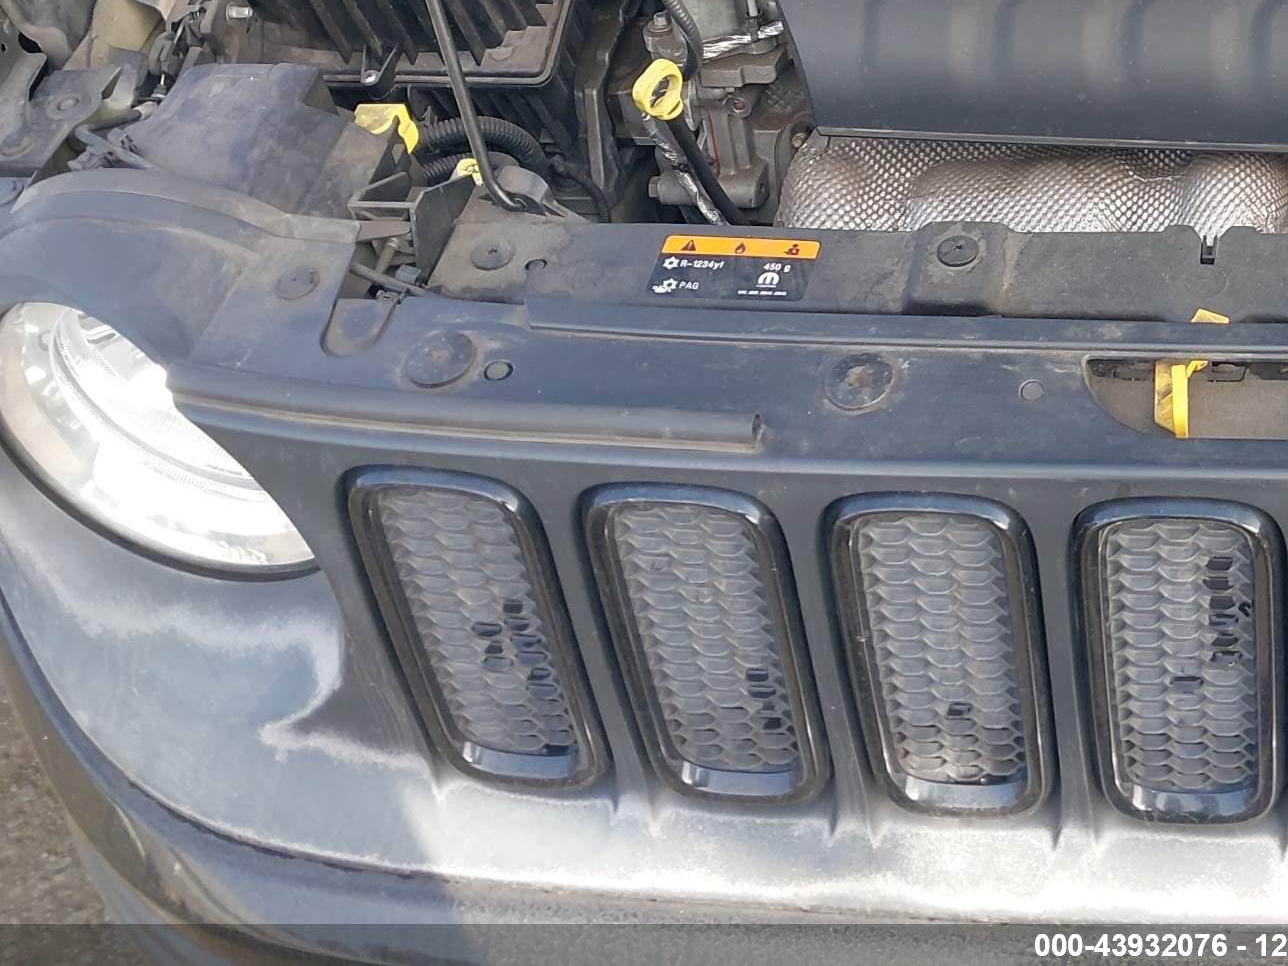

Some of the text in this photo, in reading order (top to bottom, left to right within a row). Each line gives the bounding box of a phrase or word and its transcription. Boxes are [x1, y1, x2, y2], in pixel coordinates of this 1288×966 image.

[680, 259, 724, 270] R-1234yf
[763, 262, 781, 272] 450
[679, 281, 699, 289] PAG
